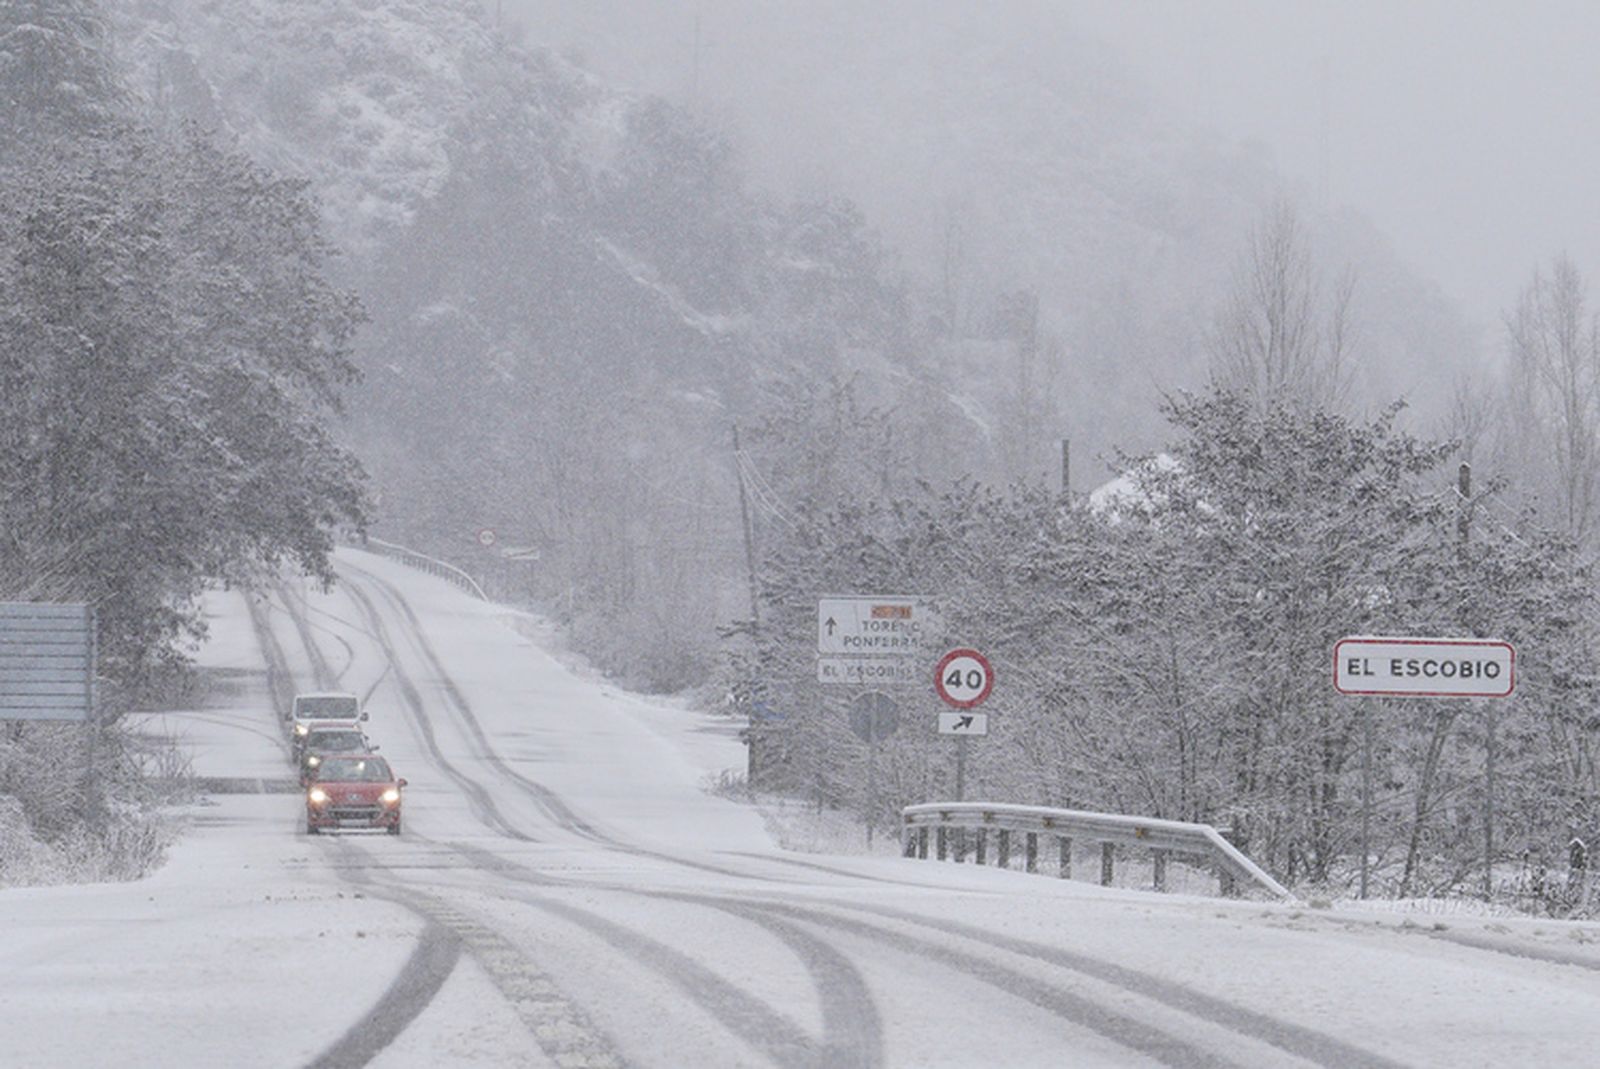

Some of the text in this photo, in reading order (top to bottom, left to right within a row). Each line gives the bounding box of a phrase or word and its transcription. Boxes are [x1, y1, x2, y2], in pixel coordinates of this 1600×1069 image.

[843, 635, 931, 648] PONFERRA
[1347, 658, 1501, 679] EL ESCOBIO
[945, 670, 983, 690] 40
